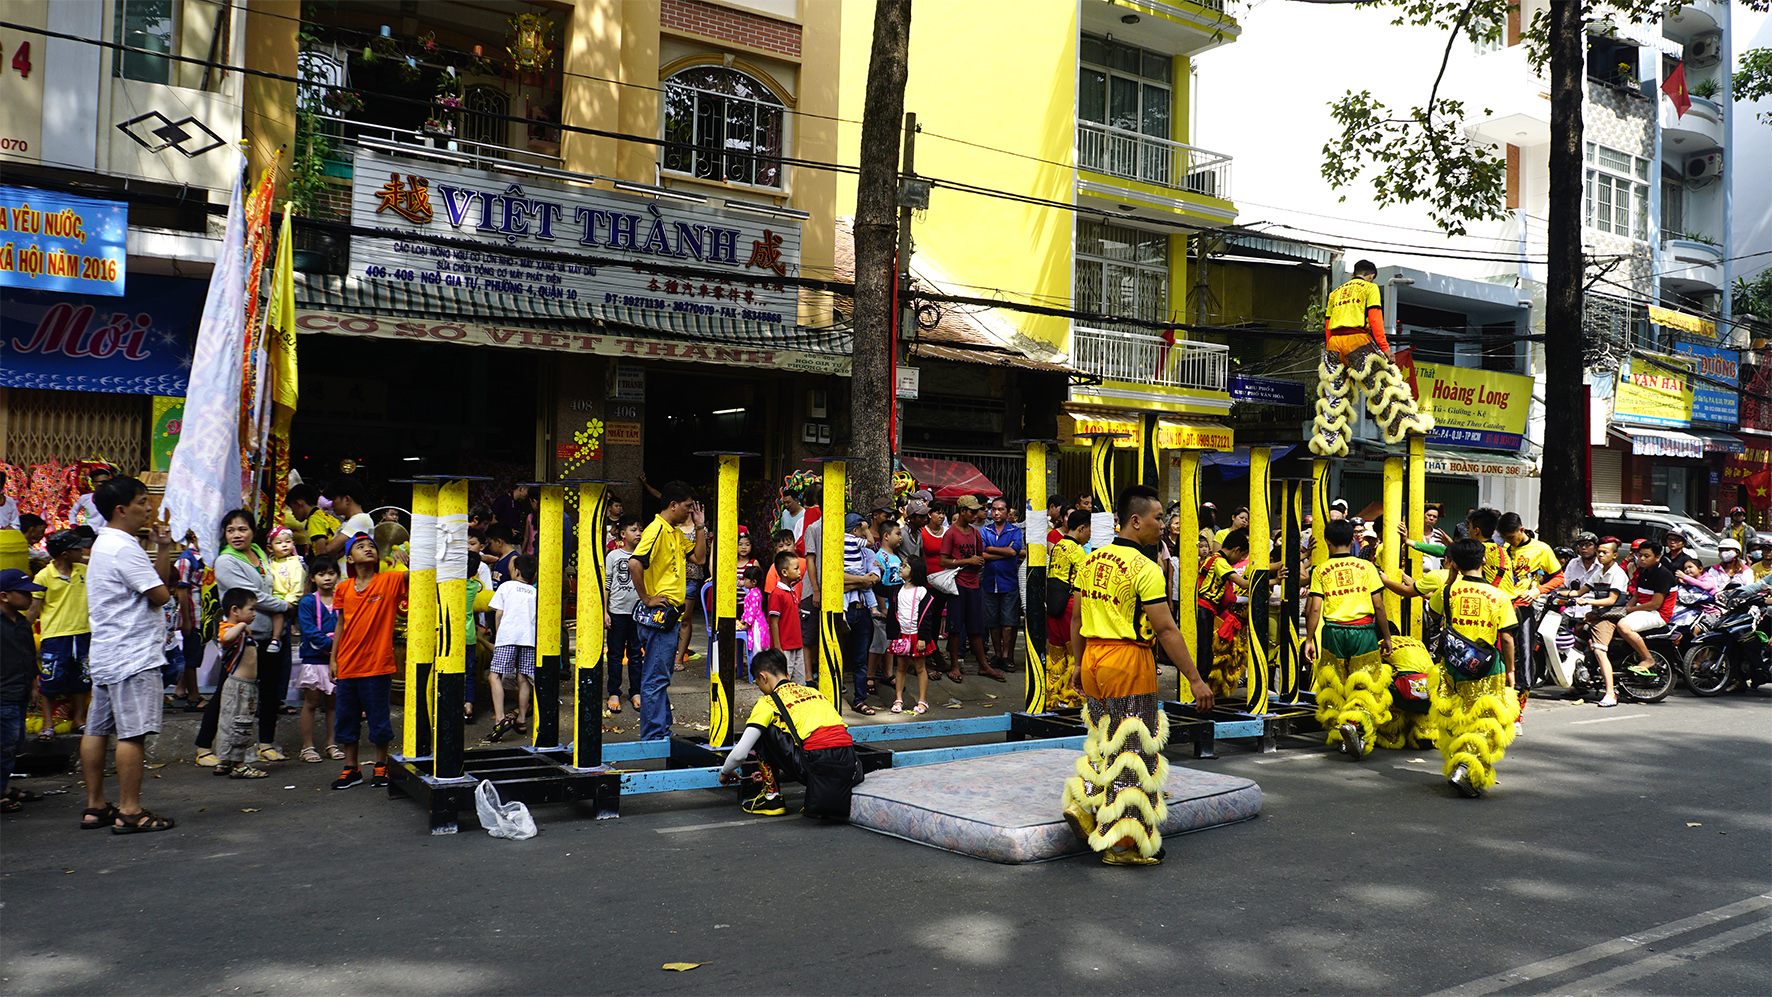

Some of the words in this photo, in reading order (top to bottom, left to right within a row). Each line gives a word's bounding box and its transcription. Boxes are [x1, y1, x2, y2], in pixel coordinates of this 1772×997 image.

[0, 40, 31, 78] 4
[375, 172, 433, 223] 越
[11, 203, 41, 234] YÊU
[44, 208, 86, 243] NƯỚC,
[438, 183, 562, 243] VIỆT
[575, 203, 742, 268] THÀNH
[18, 244, 44, 278] HỘI
[47, 249, 77, 278] NĂM
[82, 256, 117, 282] 2016
[746, 228, 786, 277] 成
[420, 271, 442, 285] NGÔ
[445, 274, 462, 287] GIA
[485, 278, 523, 294] PHƯỜNG
[538, 285, 563, 300] QUẬN
[720, 307, 737, 318] FAX
[12, 303, 152, 360] Mới
[393, 319, 468, 341] SỞ
[1700, 353, 1737, 379] ĐƯỜNG
[569, 399, 593, 412] 408
[1432, 379, 1476, 406] Hoàng
[1478, 384, 1510, 410] Long
[613, 405, 637, 418] 406
[1175, 432, 1182, 446] 10
[1450, 459, 1479, 473] HOÀNG
[1482, 464, 1504, 474] LONG
[617, 558, 632, 585] 9
